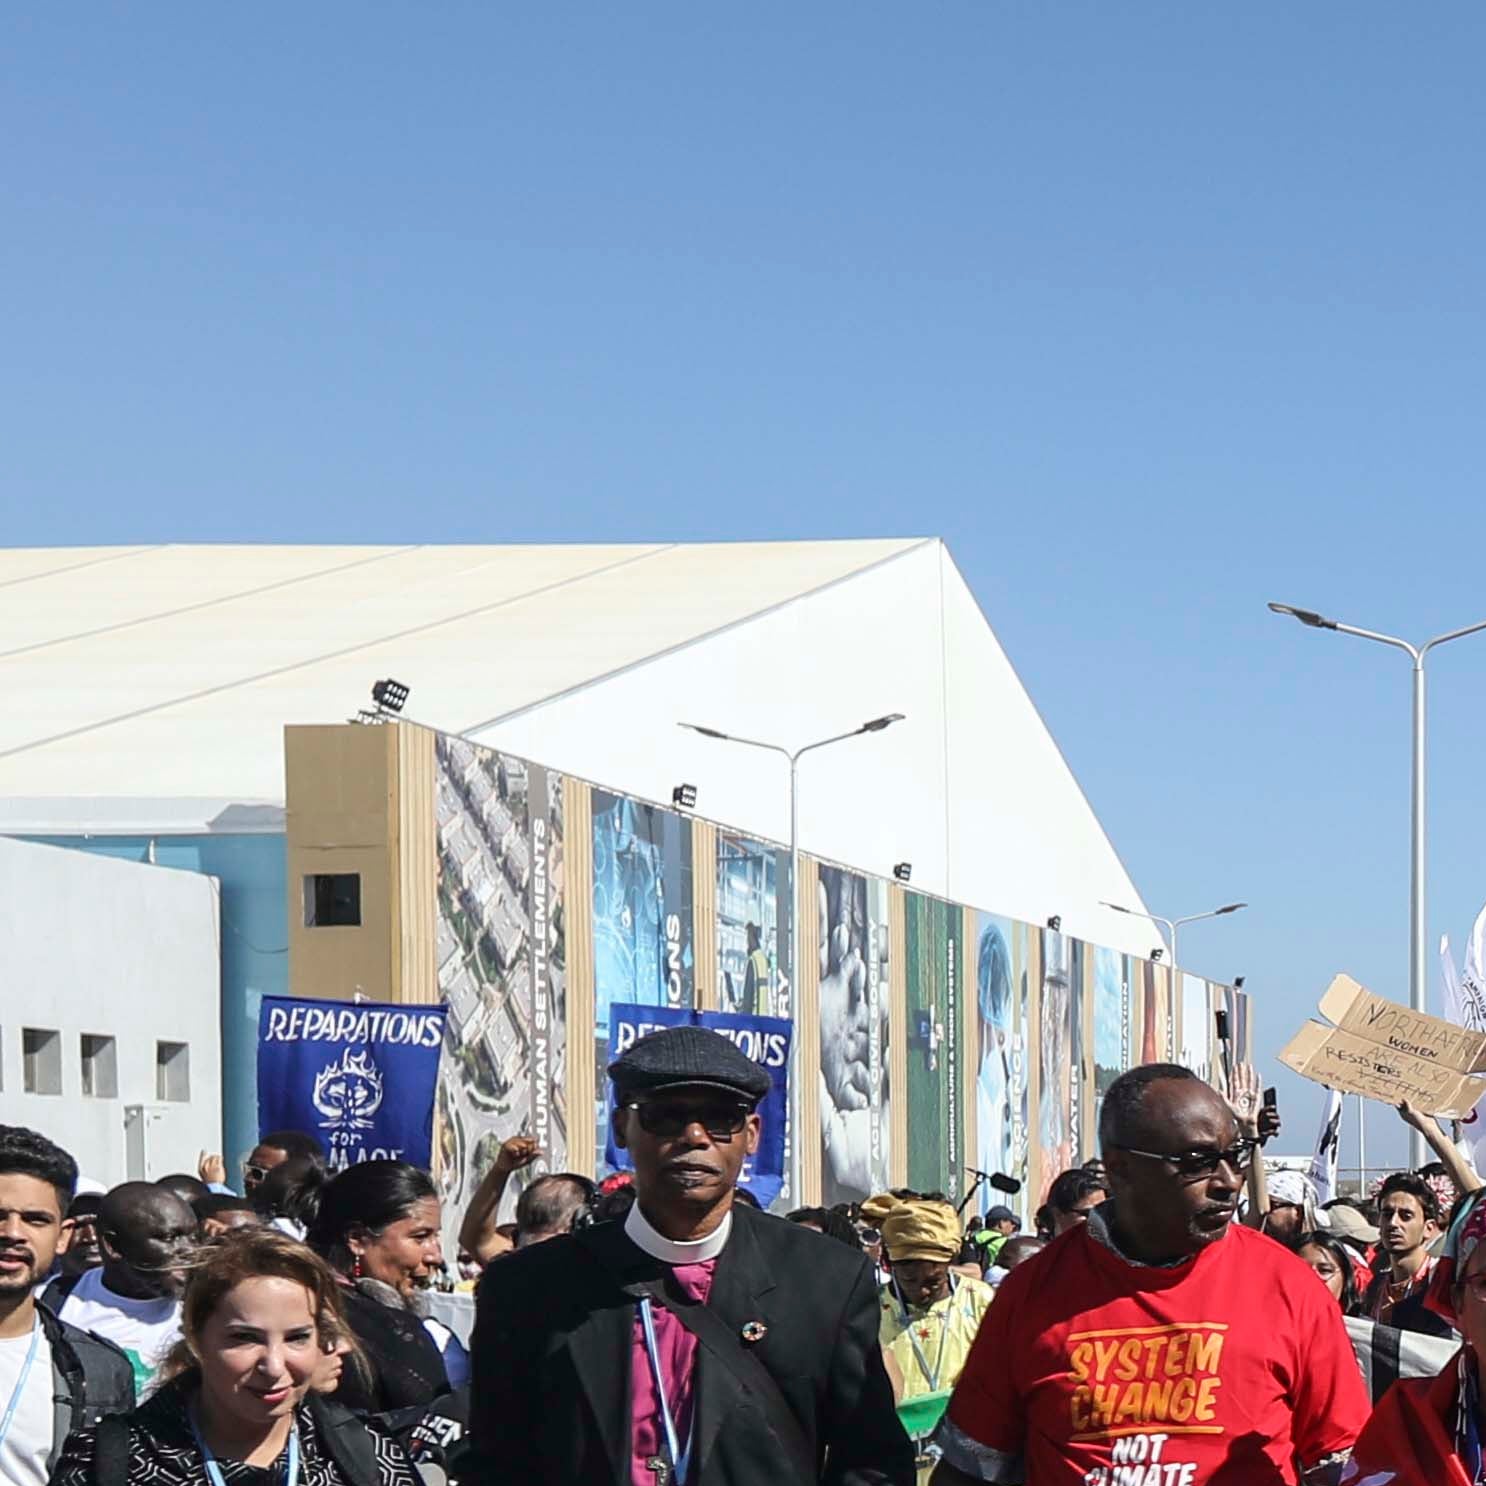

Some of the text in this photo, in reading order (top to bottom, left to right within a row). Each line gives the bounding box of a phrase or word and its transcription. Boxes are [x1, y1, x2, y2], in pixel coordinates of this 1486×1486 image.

[533, 817, 551, 1149] HUMAN SETTLEMENTS
[868, 916, 879, 1019] SOCIETY
[264, 1007, 443, 1048] REPARATIONS
[869, 1024, 880, 1085] CIVIL
[1388, 1035, 1439, 1058] WOMEN
[1012, 1033, 1022, 1162] SCIENCE
[1068, 1064, 1079, 1159] WATER
[329, 1130, 363, 1147] for
[1069, 1332, 1224, 1383] SYSTEM
[1070, 1376, 1222, 1431] CHANGE
[1111, 1434, 1168, 1465] NOT
